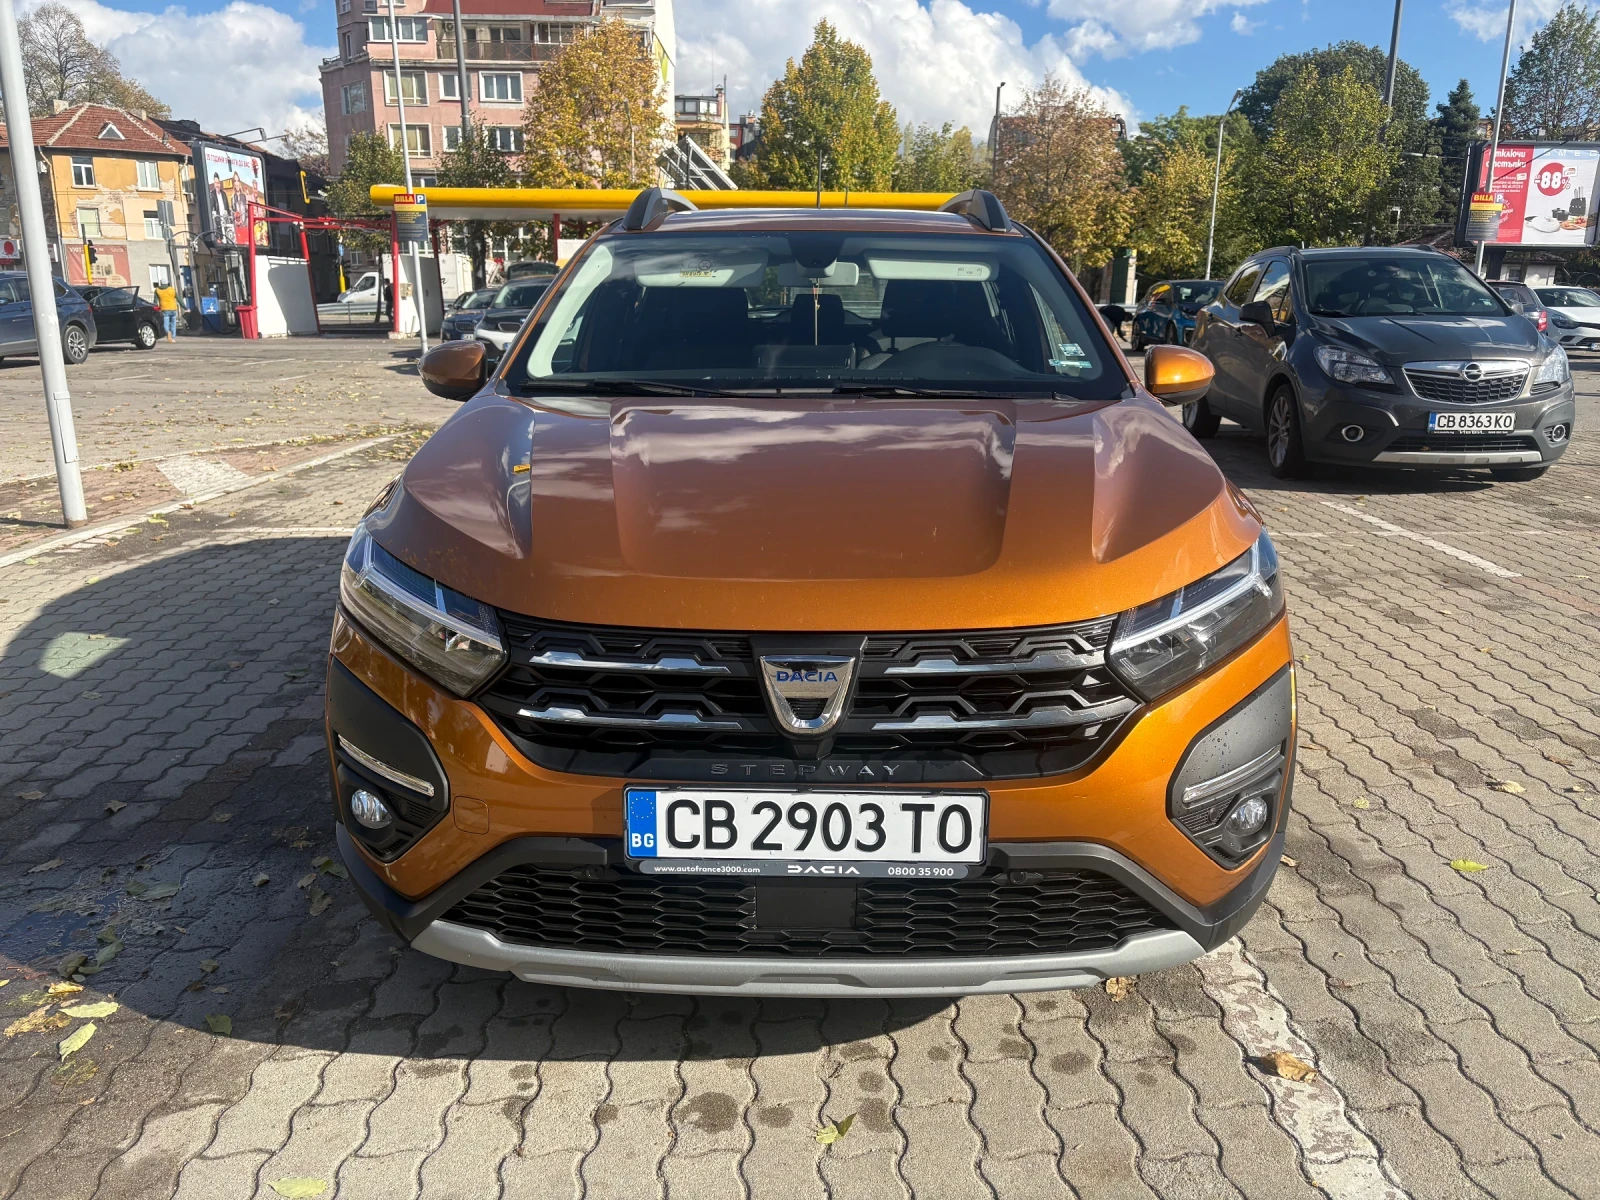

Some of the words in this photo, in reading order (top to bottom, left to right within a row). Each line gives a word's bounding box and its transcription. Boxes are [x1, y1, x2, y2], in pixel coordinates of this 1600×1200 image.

[416, 195, 424, 203] P
[1496, 194, 1503, 202] P
[1437, 414, 1456, 428] CB
[1458, 414, 1492, 428] 8363
[1494, 414, 1513, 428] KO
[776, 670, 838, 682] DACIA
[710, 763, 902, 777] STEPWAY
[631, 833, 655, 848] BG
[666, 799, 738, 850] CB
[751, 800, 887, 853] 2903
[901, 802, 972, 853] TO
[653, 865, 761, 874] www.autofrance3000.com
[787, 865, 861, 875] DACIA
[887, 866, 915, 876] 0800
[917, 867, 931, 876] 35
[931, 867, 955, 877] 900
